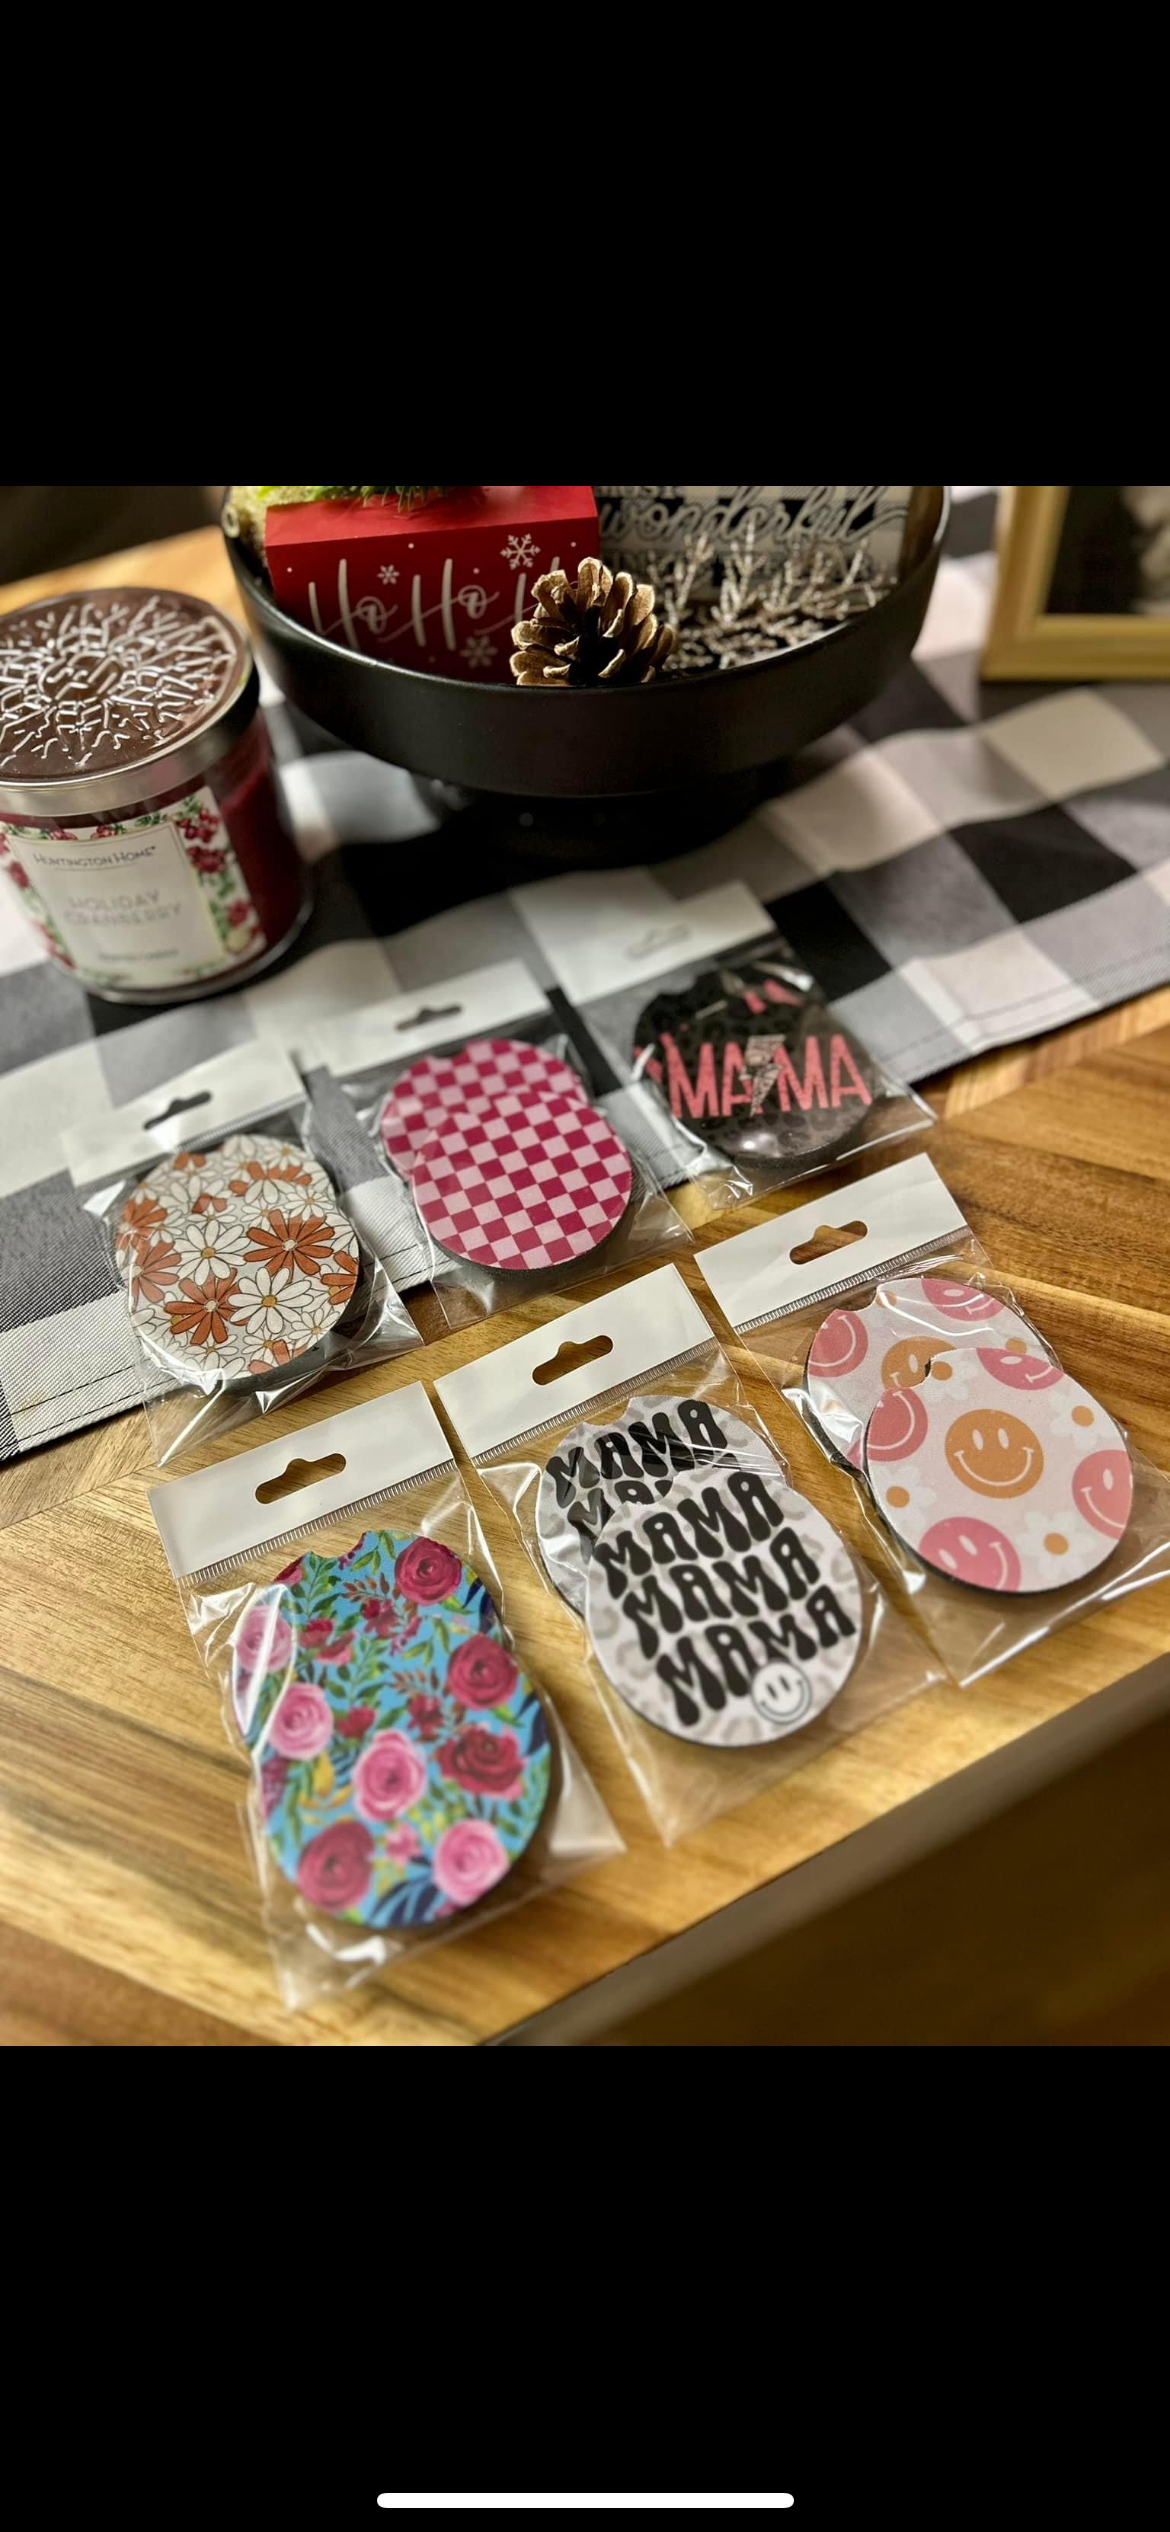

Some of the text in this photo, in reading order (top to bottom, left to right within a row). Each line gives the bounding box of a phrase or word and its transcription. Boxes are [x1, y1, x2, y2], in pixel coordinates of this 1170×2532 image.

[32, 845, 153, 868] HUNTINGTON HOME
[67, 888, 160, 911] HOLIDAY
[546, 1399, 728, 1509] MAMA
[594, 1471, 784, 1599] MAMA
[622, 1527, 820, 1660] MAMA
[656, 1585, 856, 1726] MAMA
